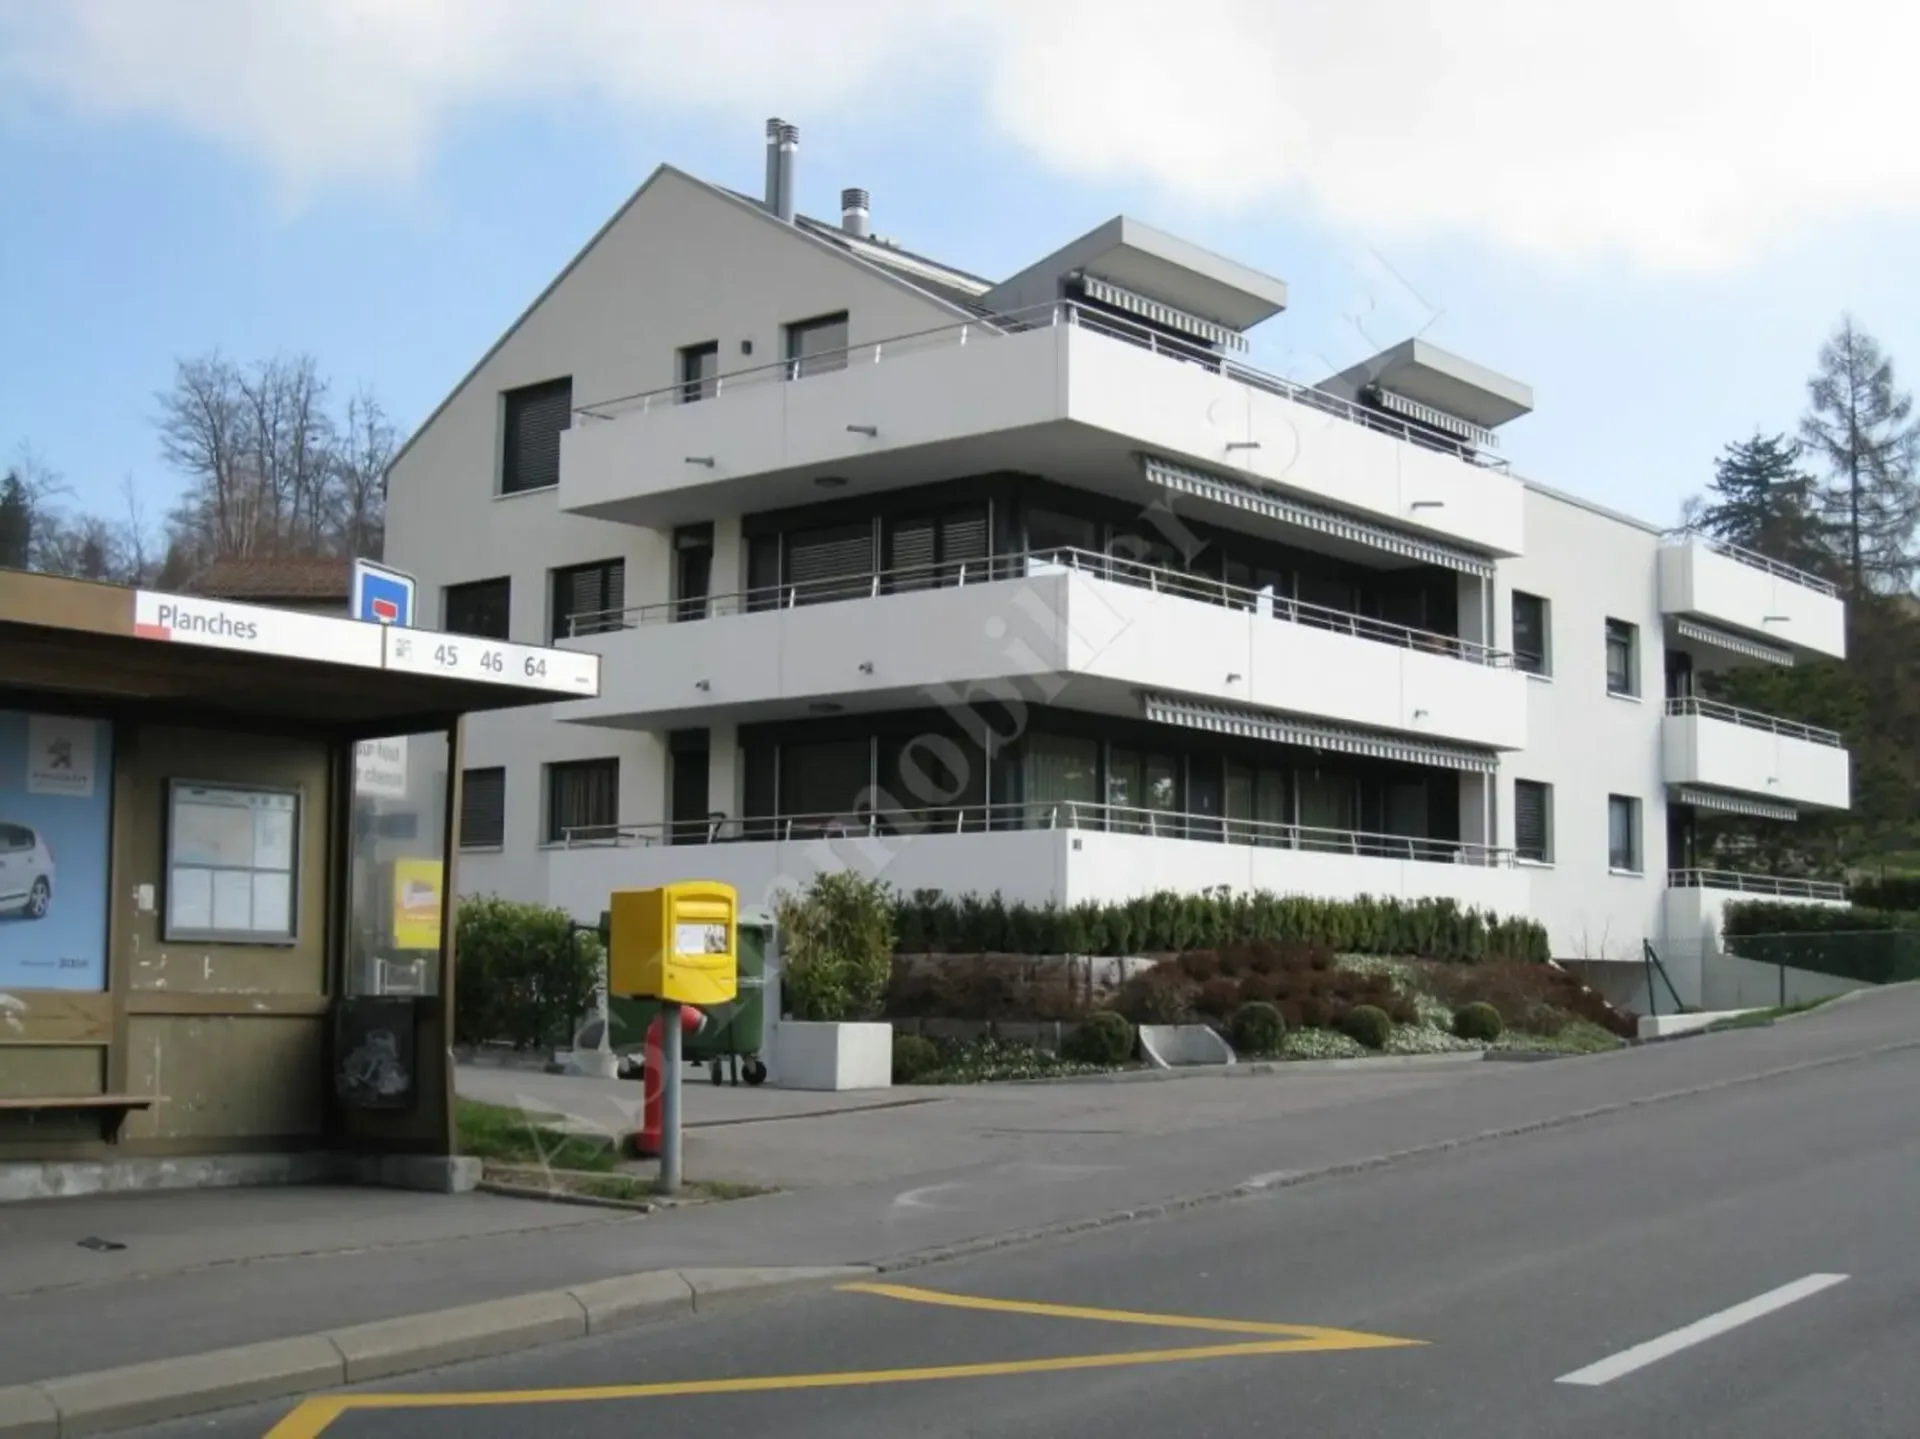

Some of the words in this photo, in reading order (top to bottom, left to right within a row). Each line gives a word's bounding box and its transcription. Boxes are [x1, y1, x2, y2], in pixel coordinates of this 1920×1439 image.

[158, 604, 258, 640] Planches
[434, 645, 458, 666] 45
[480, 651, 503, 673] 46
[524, 656, 546, 677] 64
